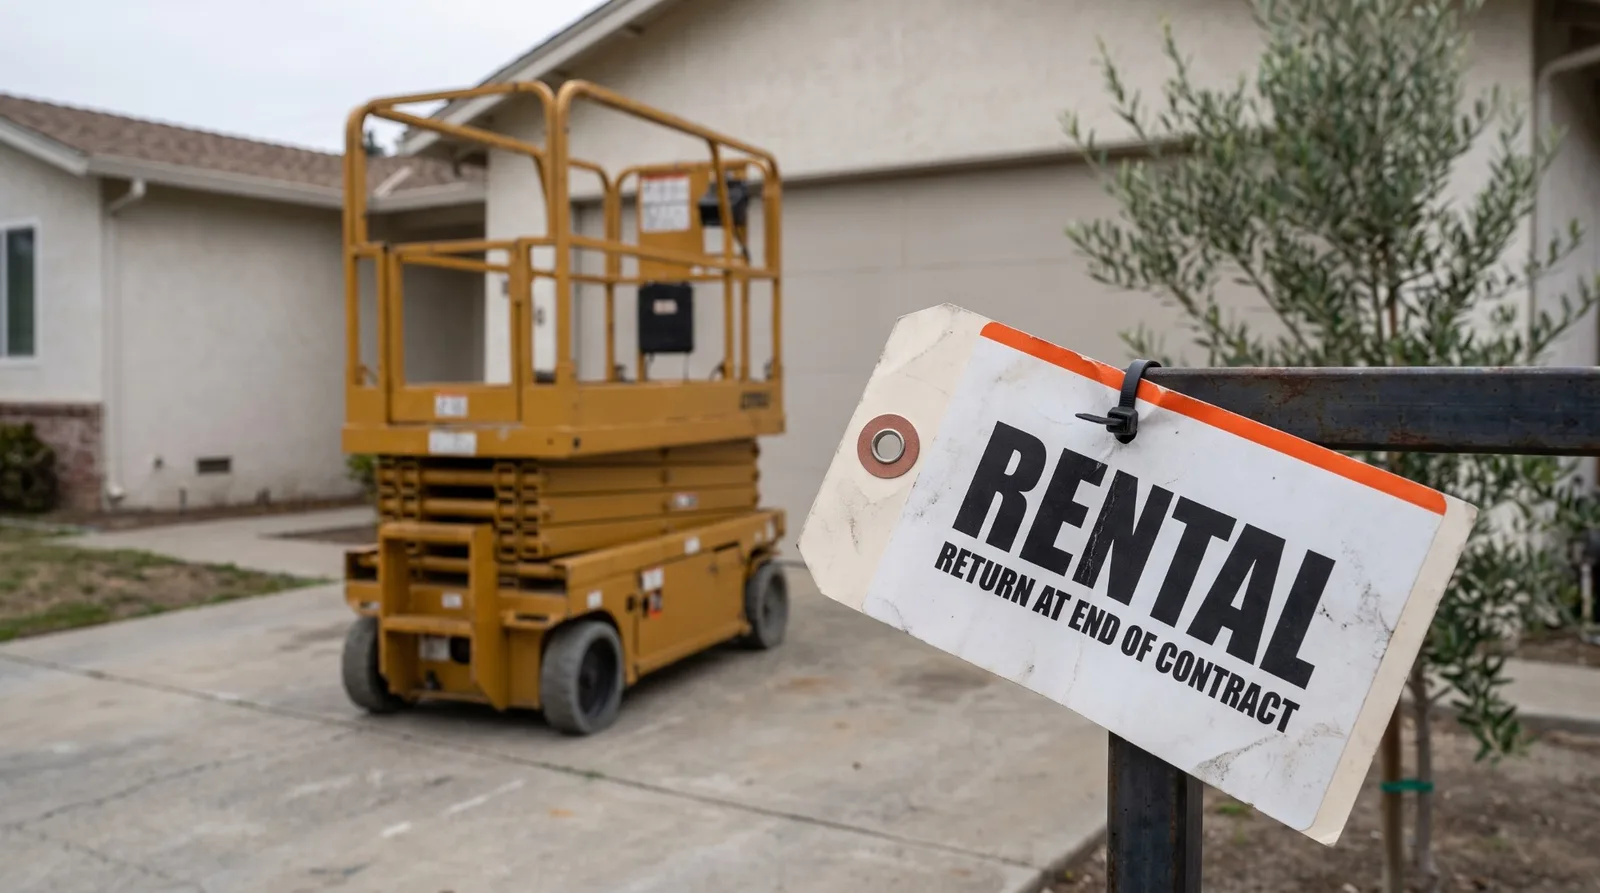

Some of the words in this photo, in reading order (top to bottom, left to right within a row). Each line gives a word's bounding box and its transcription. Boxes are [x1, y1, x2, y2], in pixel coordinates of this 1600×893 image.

[935, 541, 1037, 607] RETURN
[1032, 585, 1071, 621] AT
[1068, 599, 1120, 645] END
[1121, 625, 1157, 662] OF
[1156, 642, 1300, 733] CONTRACT
[952, 421, 1336, 690] RENTAL
